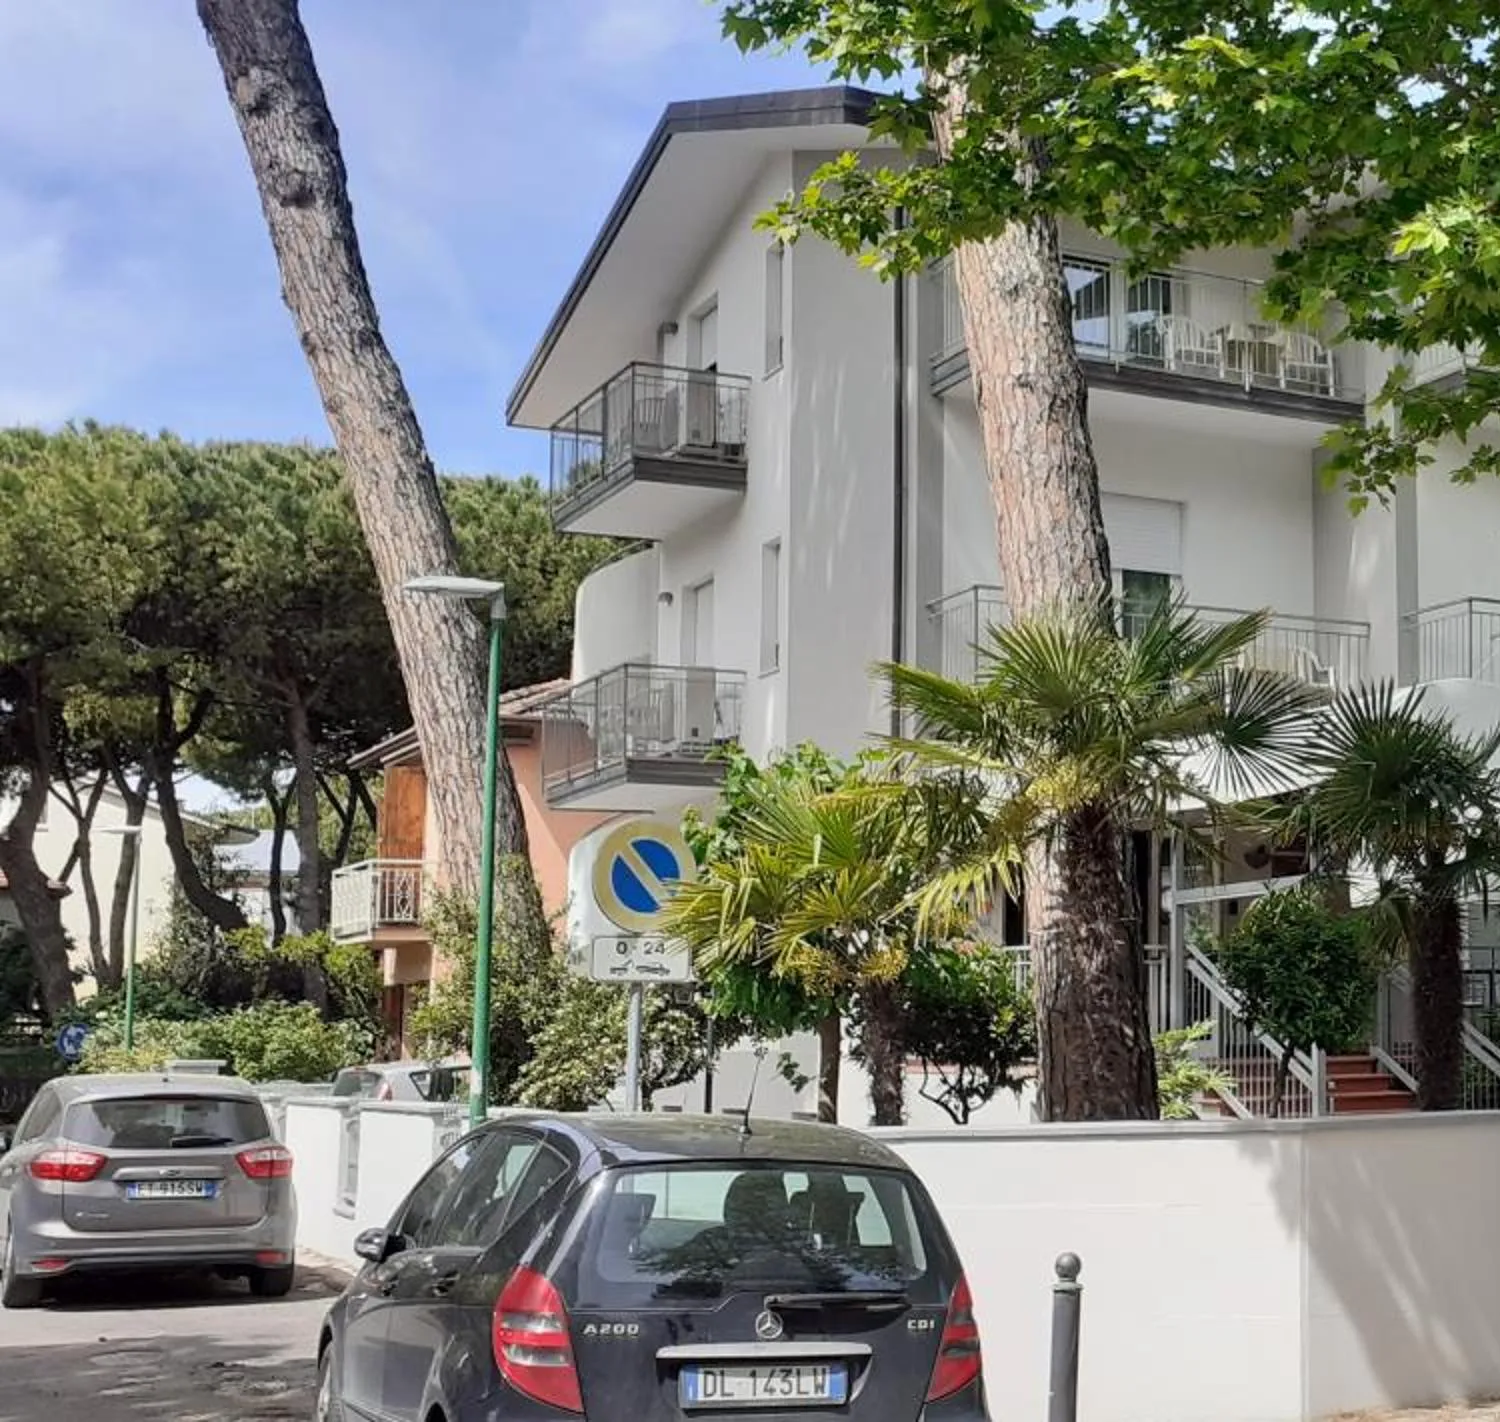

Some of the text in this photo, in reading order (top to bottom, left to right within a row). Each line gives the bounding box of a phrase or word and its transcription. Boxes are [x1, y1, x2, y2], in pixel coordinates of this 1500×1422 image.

[616, 941, 628, 955] 0
[644, 941, 665, 955] 24
[583, 1323, 640, 1335] A200
[907, 1319, 935, 1329] CDI
[703, 1367, 827, 1398] DL 143LW
